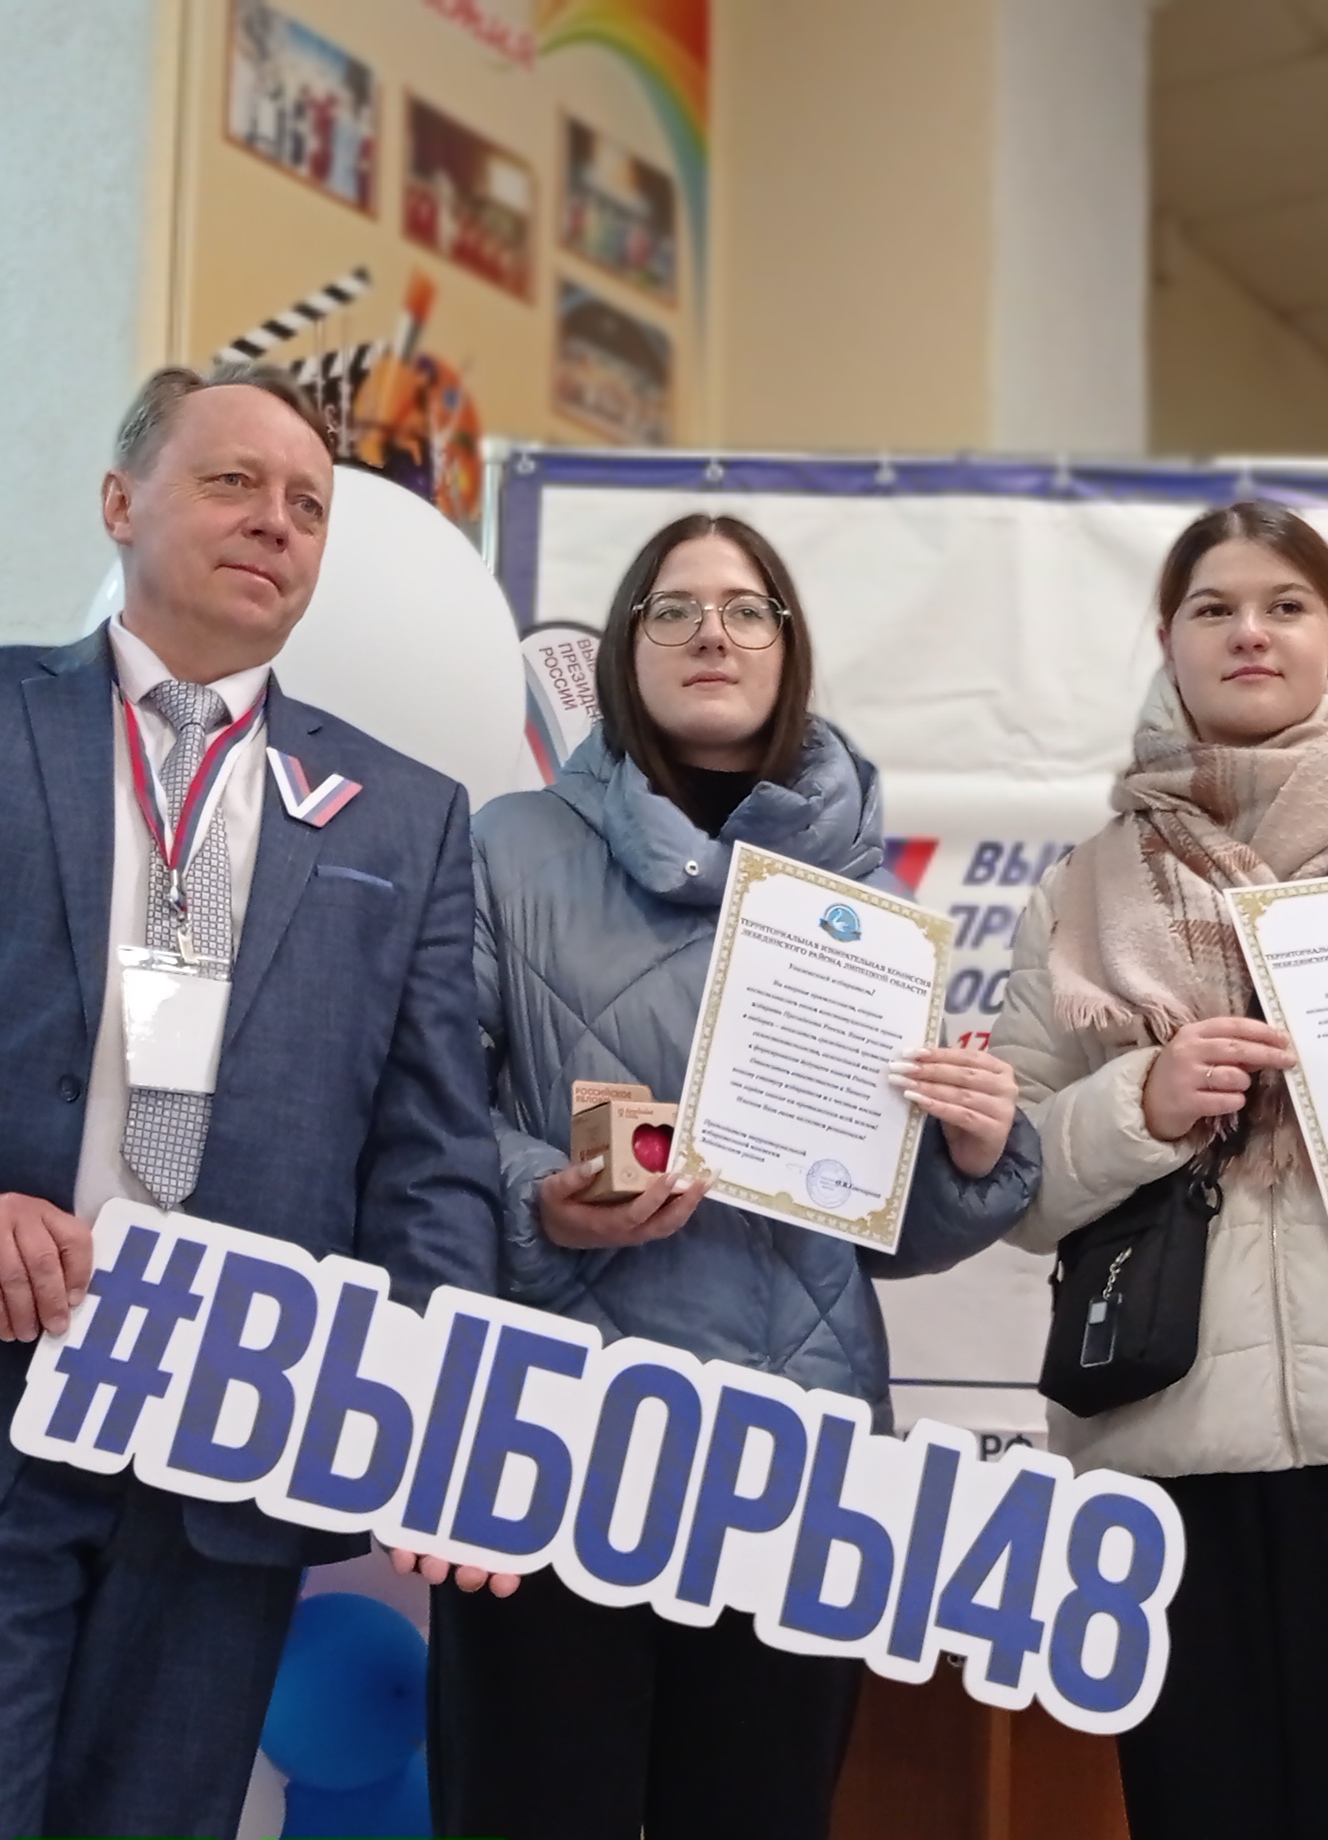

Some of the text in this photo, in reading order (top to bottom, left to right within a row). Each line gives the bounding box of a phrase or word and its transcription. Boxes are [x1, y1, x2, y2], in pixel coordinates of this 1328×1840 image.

[539, 646, 578, 711] РОССИИ
[889, 977, 926, 996] ОБЛАСТИ
[45, 1226, 1166, 1714] #ВЫБОРЫ48
